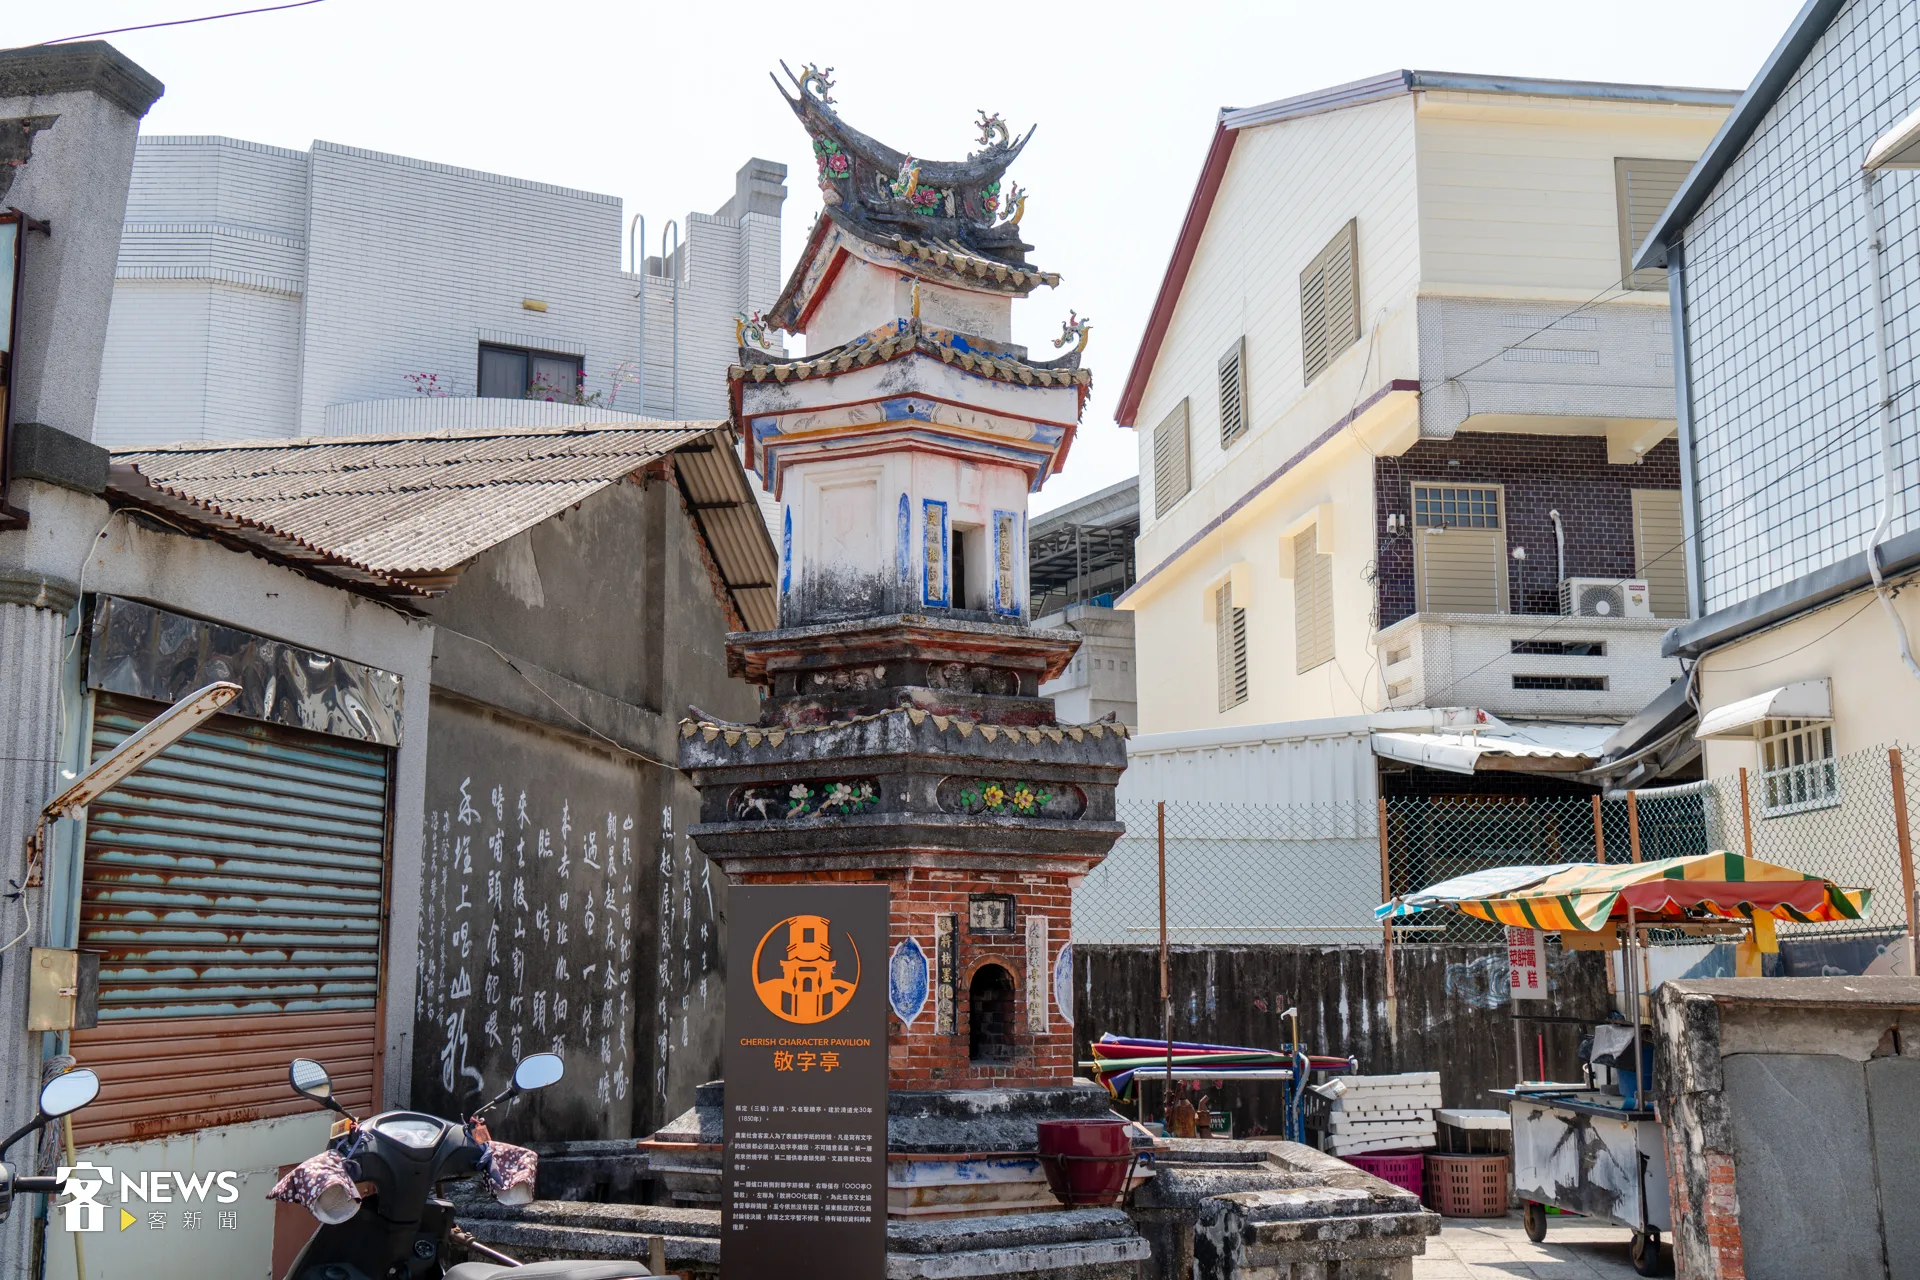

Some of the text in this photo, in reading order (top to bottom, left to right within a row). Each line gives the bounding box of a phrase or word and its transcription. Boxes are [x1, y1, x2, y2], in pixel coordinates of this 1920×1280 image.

[740, 1038, 871, 1047] CHERISH CHARACTER PAVILION
[773, 1050, 840, 1072] 敬字亭
